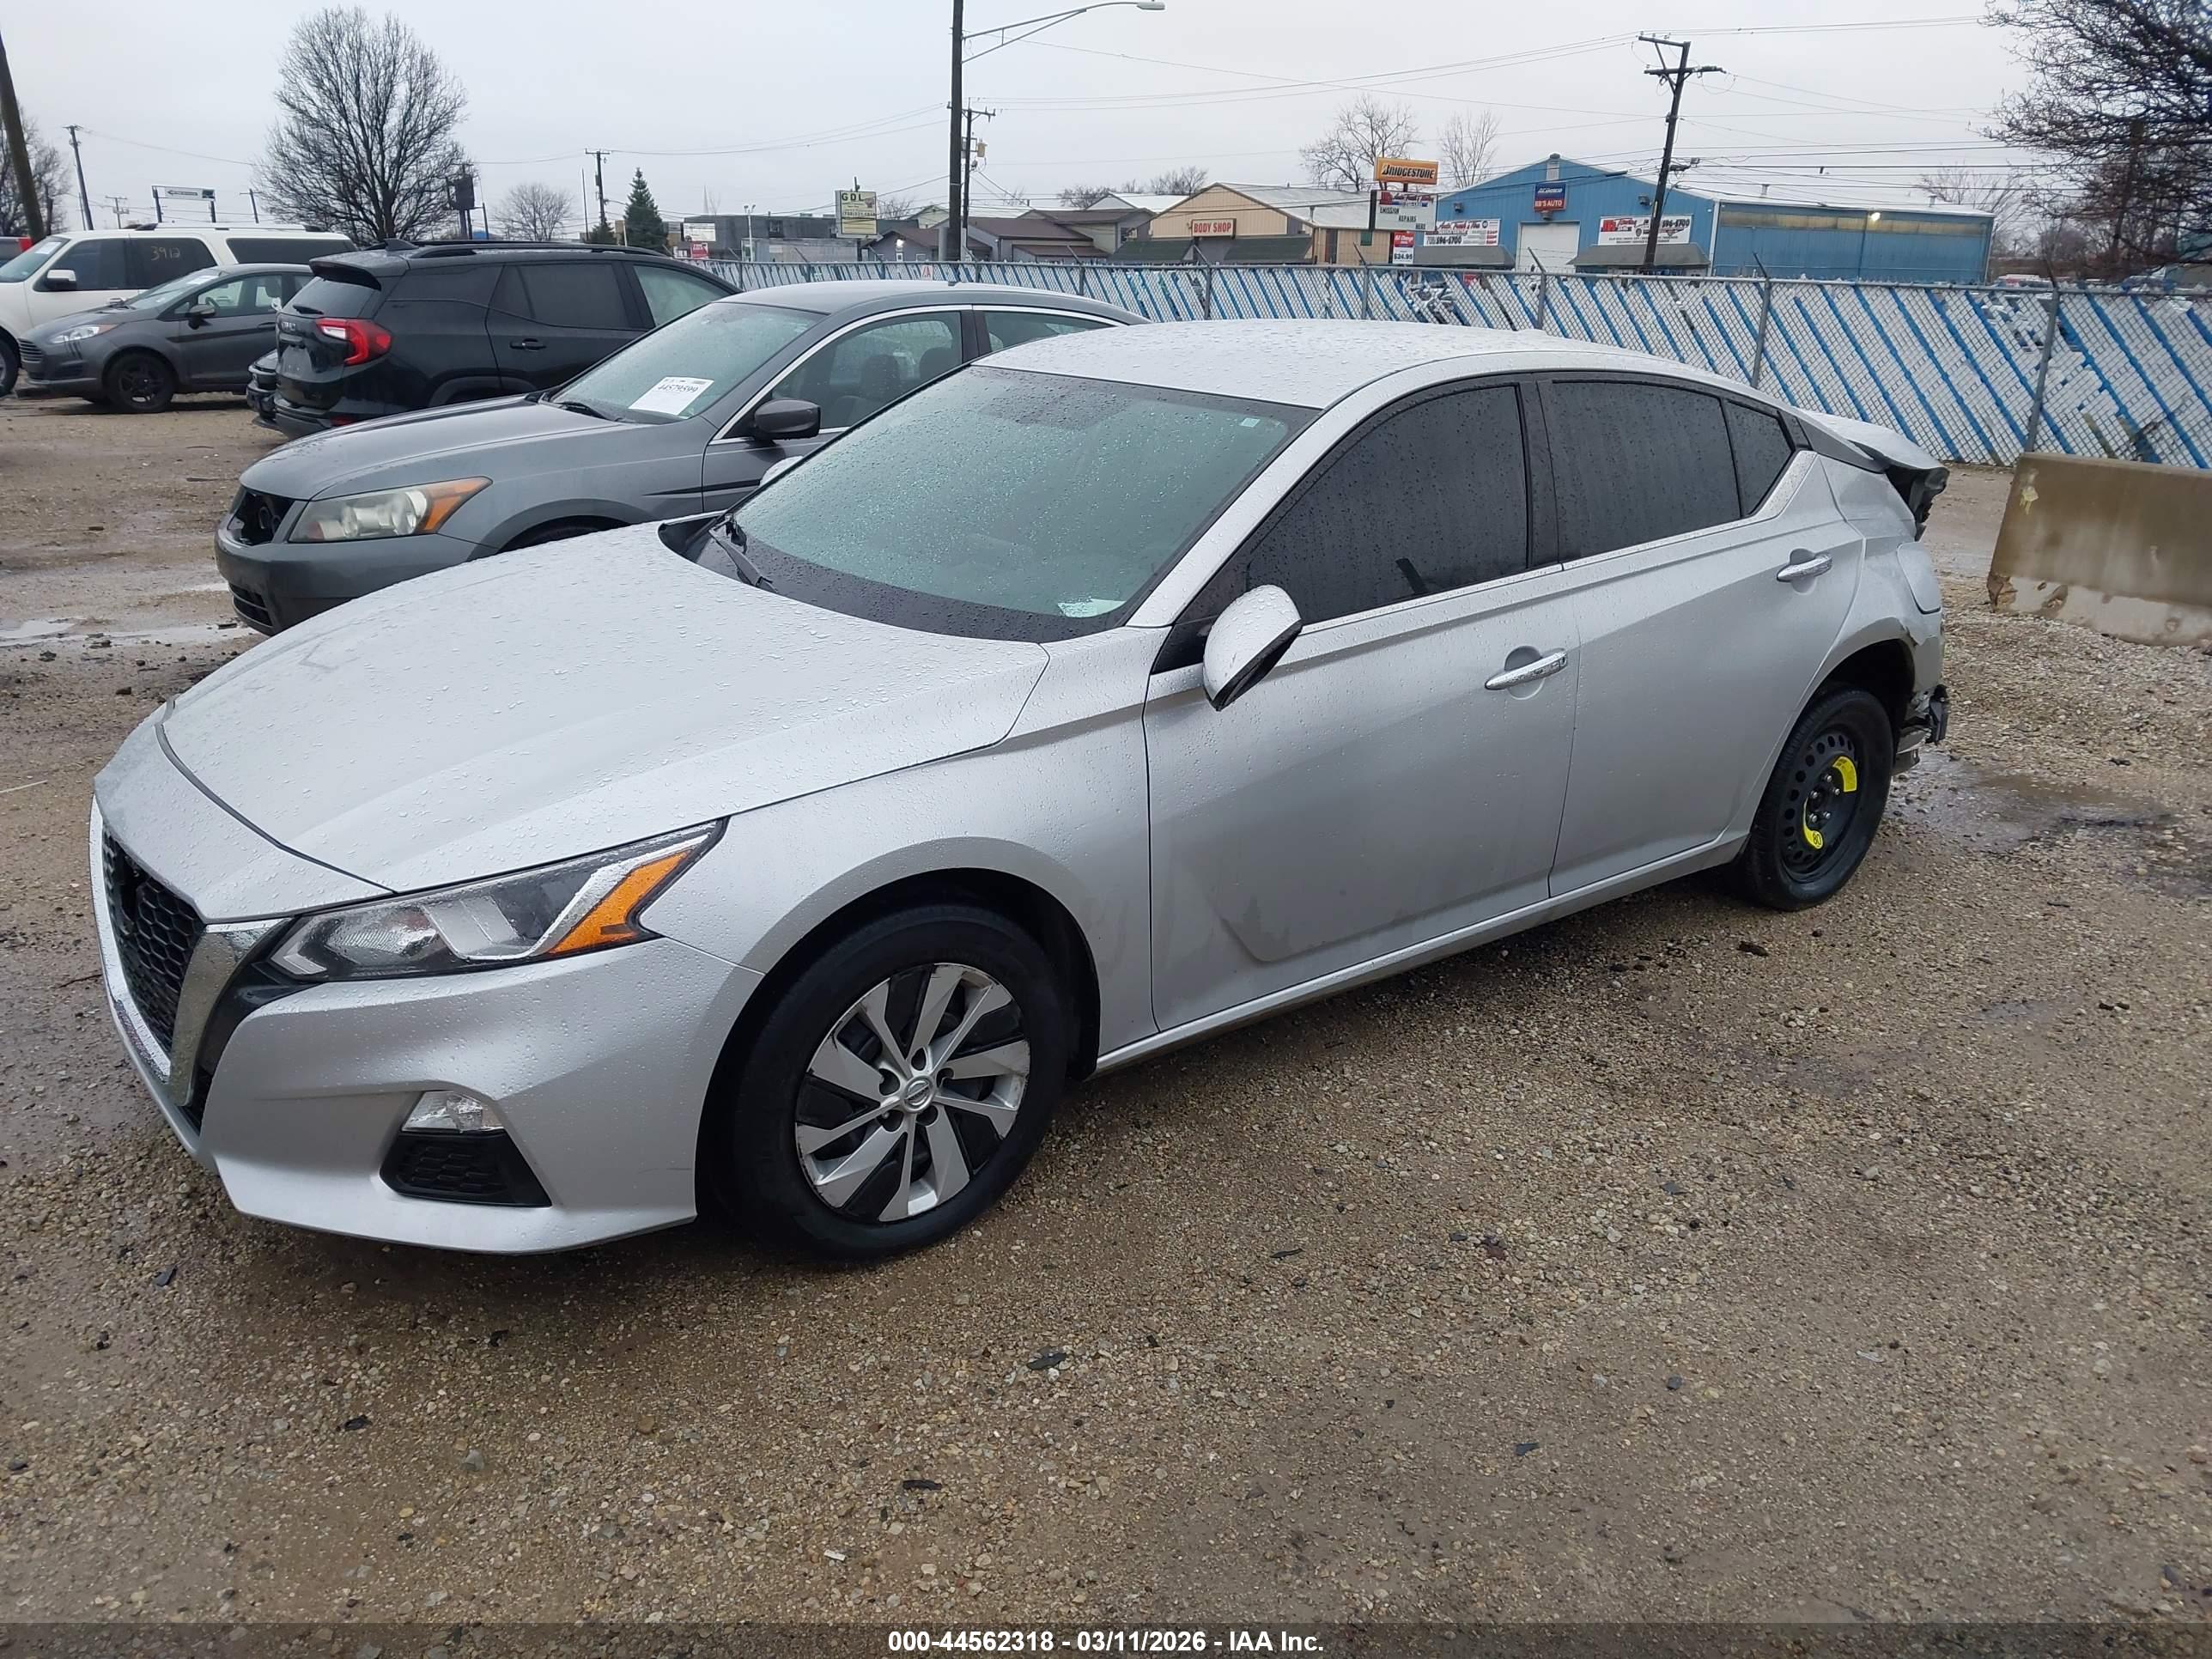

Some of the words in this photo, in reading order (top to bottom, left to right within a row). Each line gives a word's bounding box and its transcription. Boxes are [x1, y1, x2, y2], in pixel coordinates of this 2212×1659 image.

[1381, 164, 1435, 179] BRIDGESTONE
[1194, 223, 1212, 233] BODY
[1212, 222, 1232, 233] SHOP
